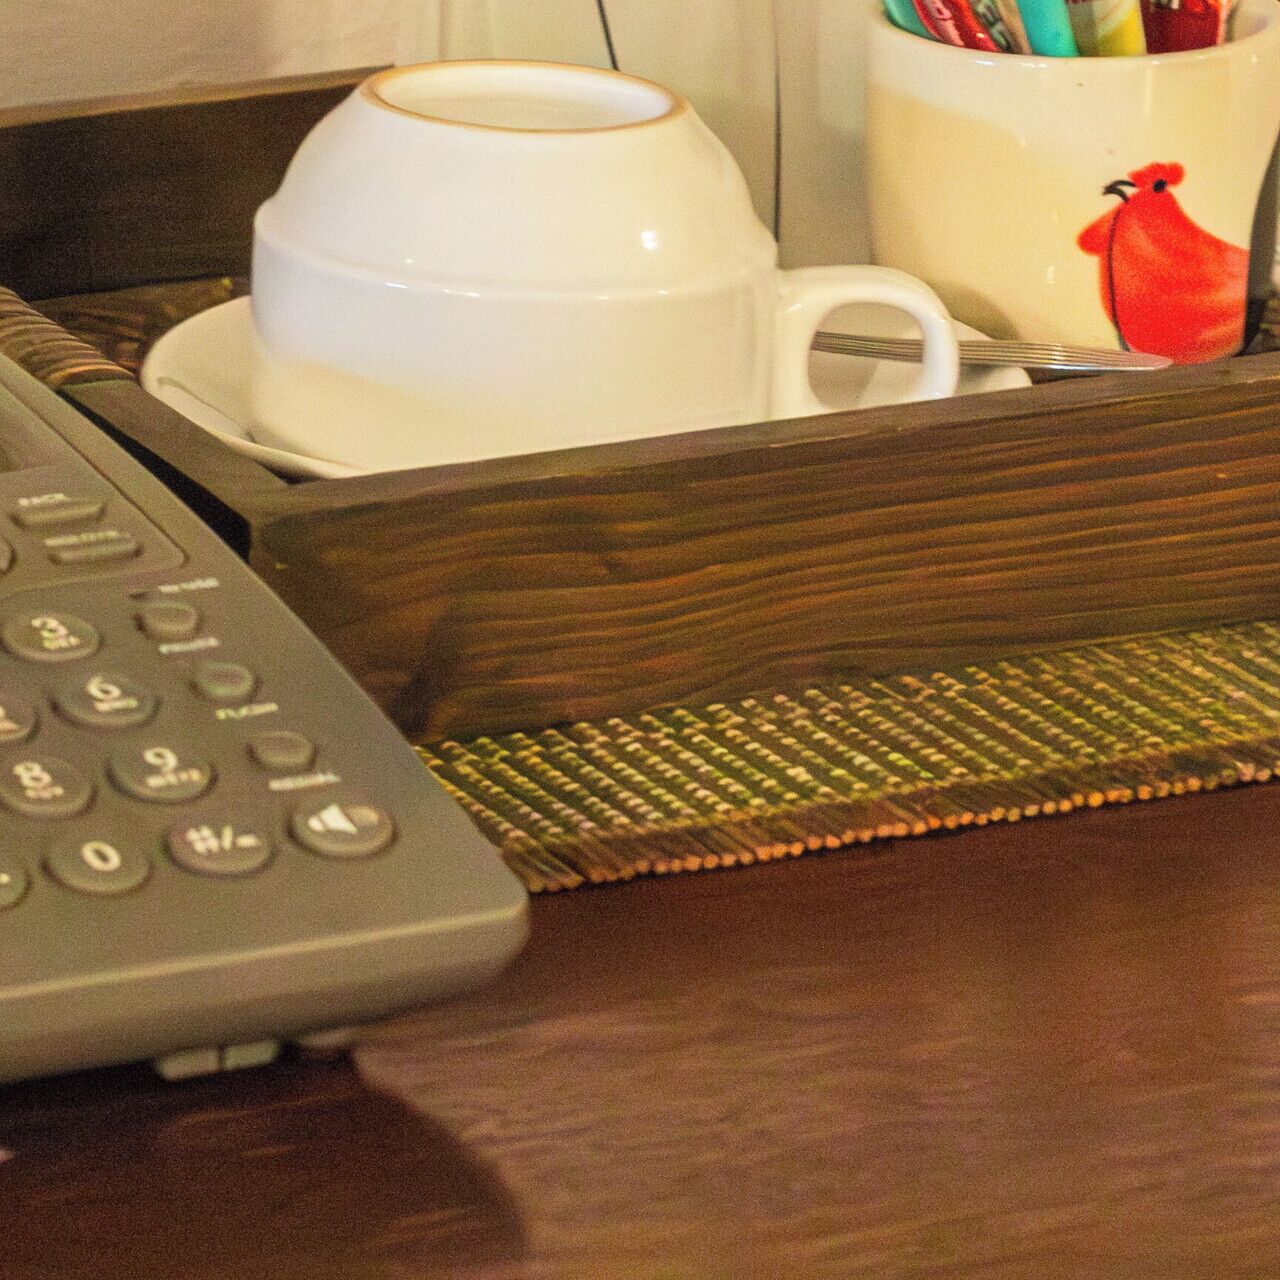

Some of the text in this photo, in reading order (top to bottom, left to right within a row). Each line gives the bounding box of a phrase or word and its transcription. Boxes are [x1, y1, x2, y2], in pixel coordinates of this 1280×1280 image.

[31, 616, 69, 641] 3
[86, 676, 121, 701] 6
[143, 747, 179, 772] 9
[13, 761, 52, 787] 8
[80, 840, 122, 872] 0
